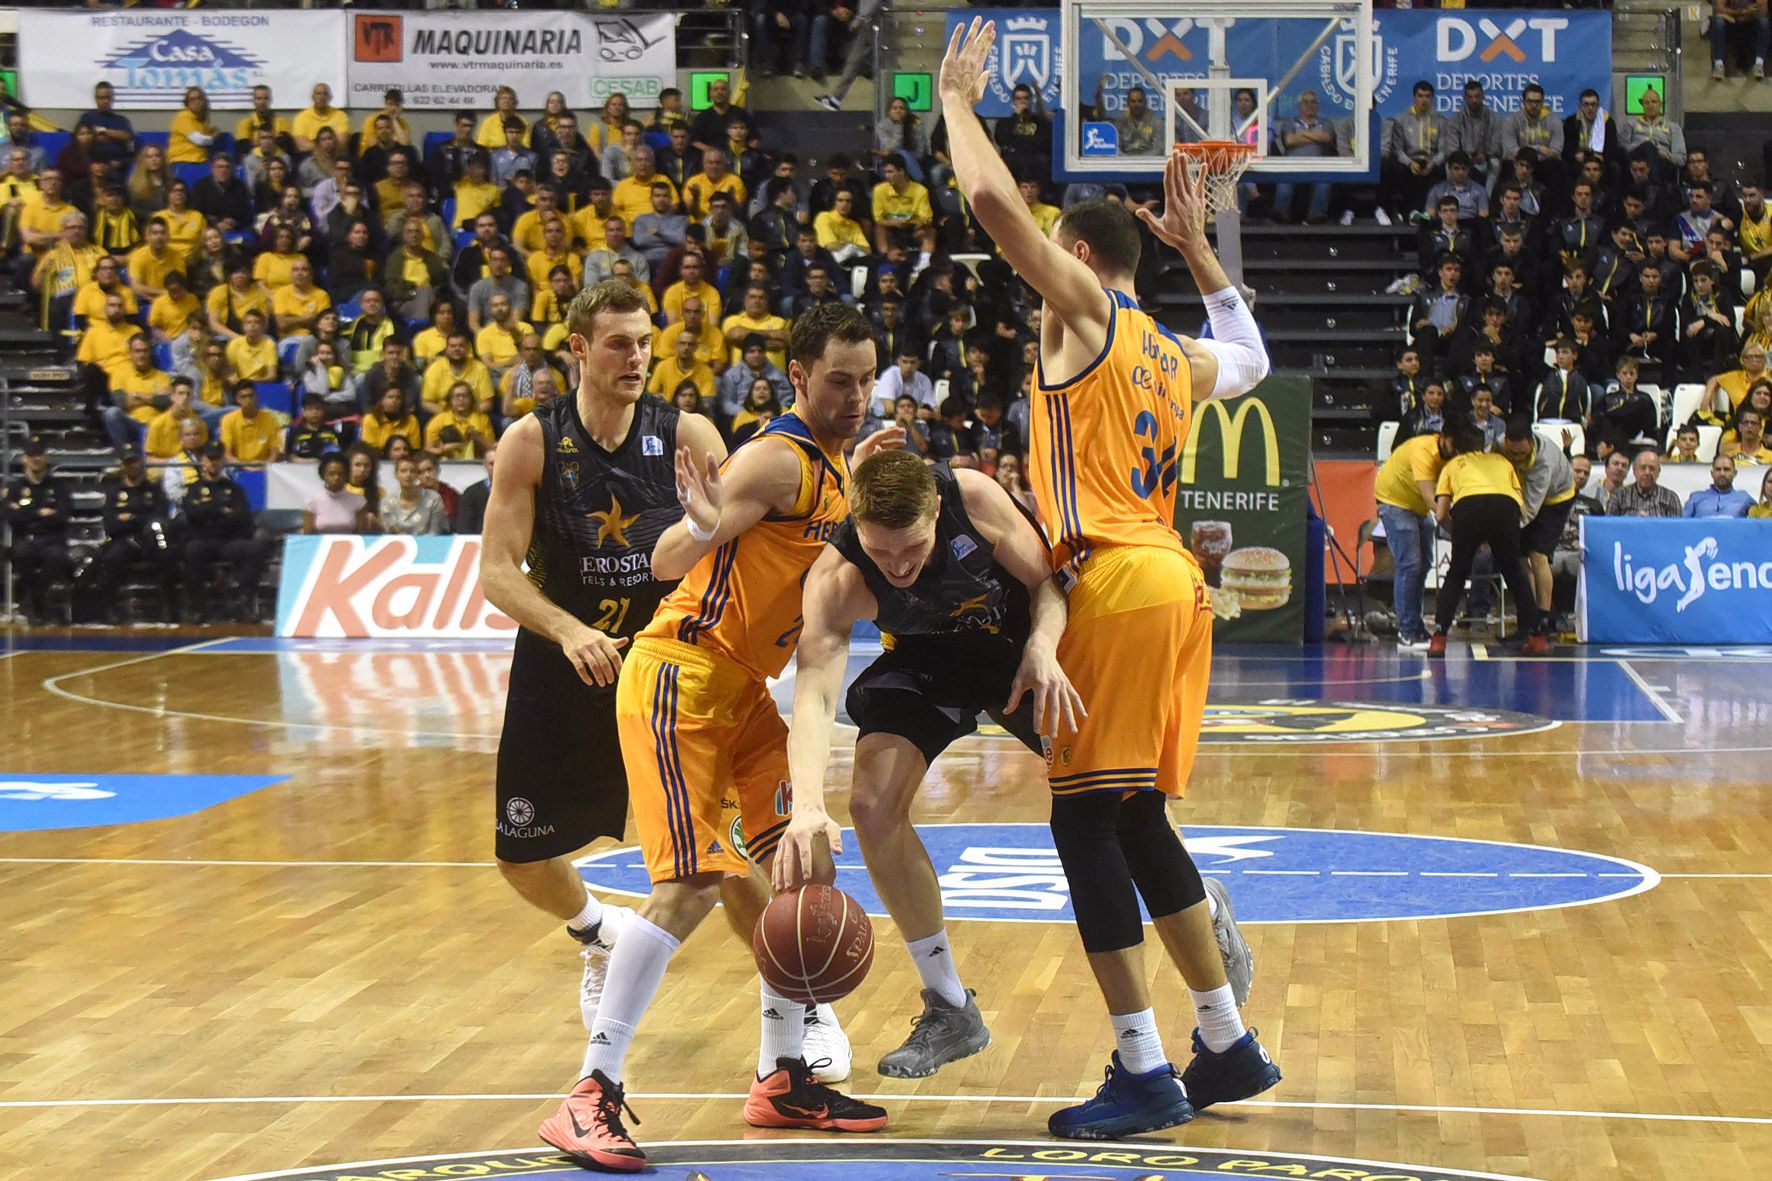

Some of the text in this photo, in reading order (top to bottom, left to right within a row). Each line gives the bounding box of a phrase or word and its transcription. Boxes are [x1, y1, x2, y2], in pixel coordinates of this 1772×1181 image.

[92, 16, 270, 27] RESTAURANTE BODEGON
[151, 39, 216, 61] Casa
[412, 29, 583, 55] MAQUINARIA
[1436, 18, 1569, 63] DXT
[430, 60, 563, 71] www.vtrmaquinaria.es
[592, 79, 661, 96] CESAB
[1436, 95, 1463, 112] DE
[1181, 489, 1280, 511] TENERIFE
[581, 552, 652, 574] EROSTA
[582, 574, 606, 587] TELS
[619, 571, 656, 587] RESORT
[592, 597, 631, 634] 21
[504, 824, 555, 839] LAGUNA
[980, 1147, 1199, 1166] LORO
